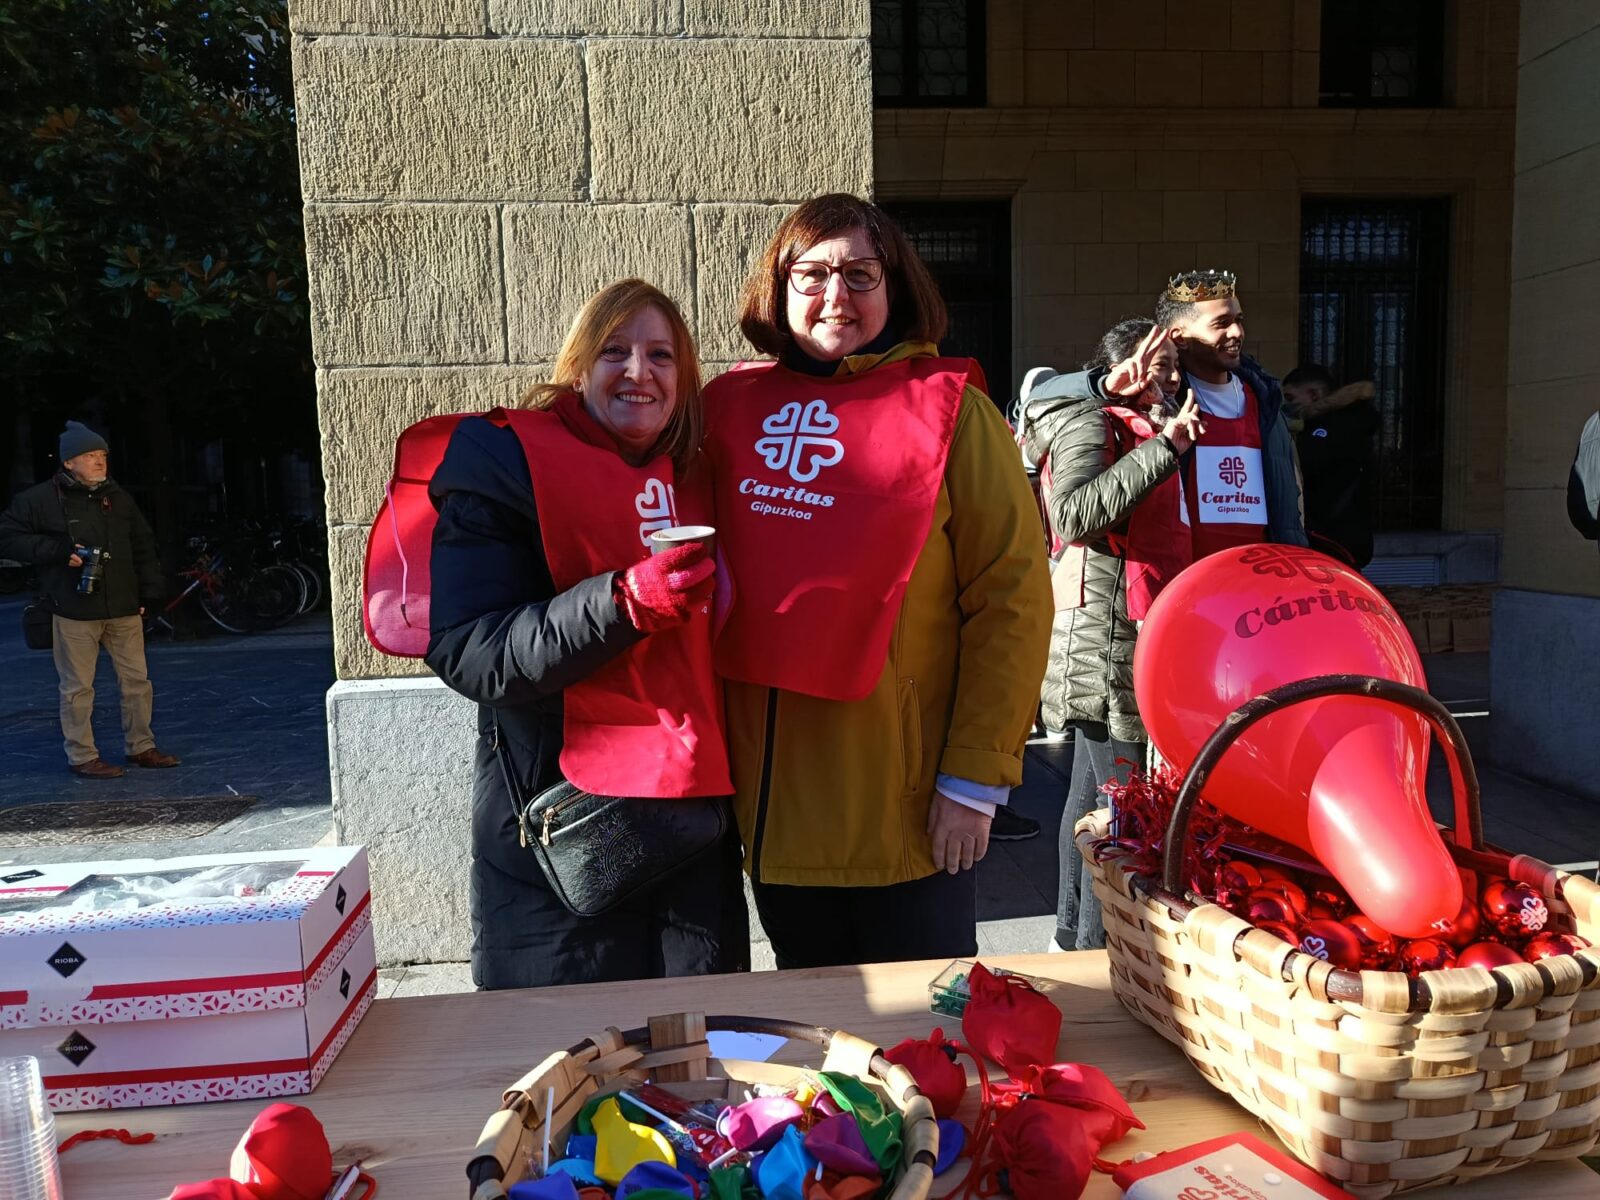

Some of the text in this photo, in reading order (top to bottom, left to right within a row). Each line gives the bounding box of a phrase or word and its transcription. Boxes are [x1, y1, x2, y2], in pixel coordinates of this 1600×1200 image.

[739, 478, 834, 506] Caritas
[1202, 491, 1261, 505] Caritas
[751, 501, 812, 519] Gipuzkoa
[1217, 506, 1250, 514] Gipuzkoa
[65, 1044, 88, 1052] RIOBA
